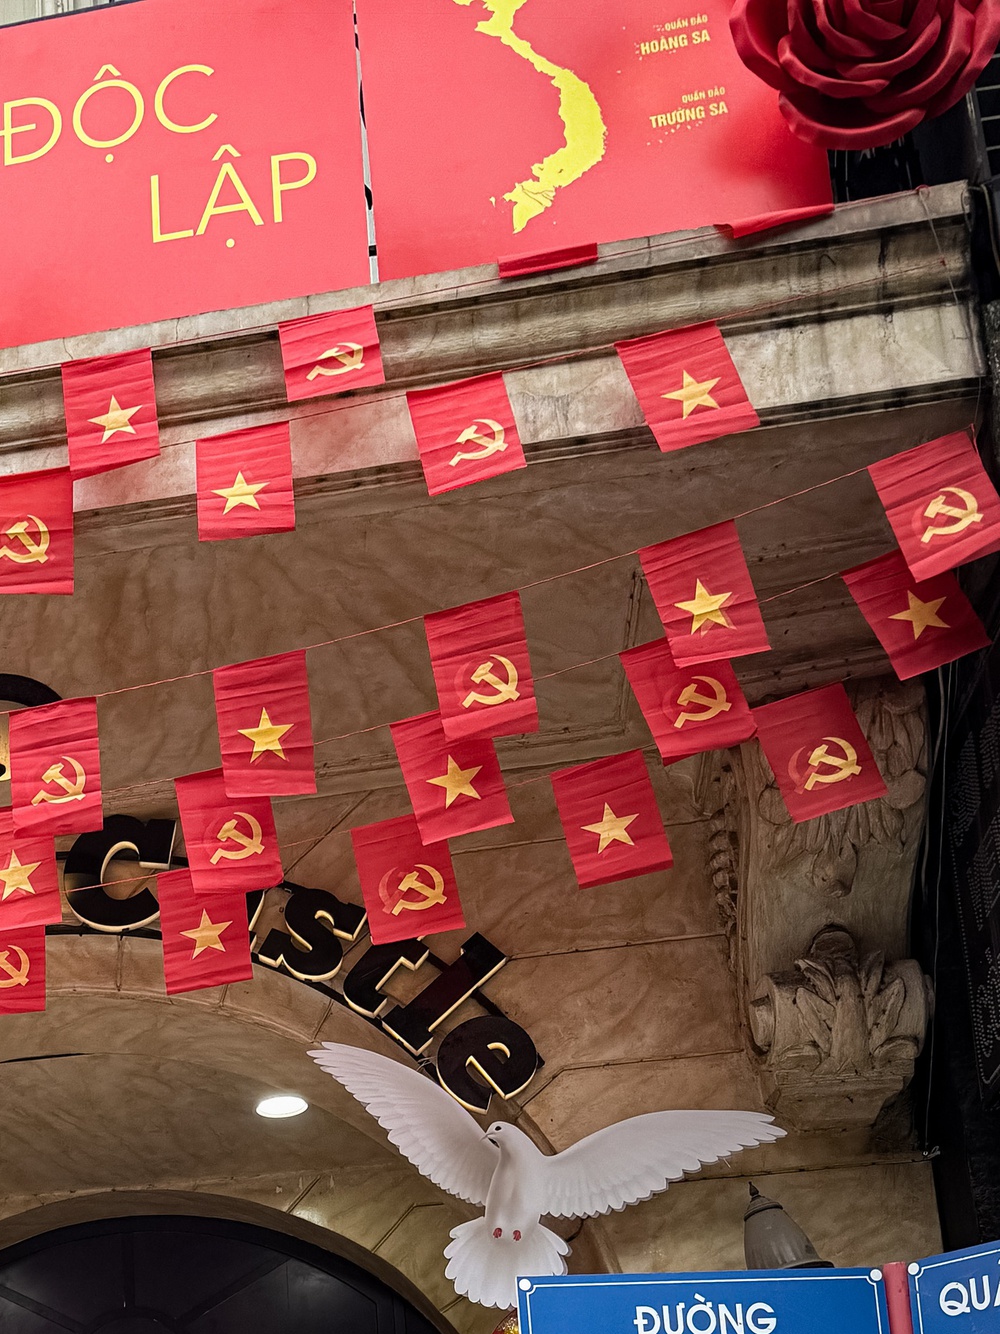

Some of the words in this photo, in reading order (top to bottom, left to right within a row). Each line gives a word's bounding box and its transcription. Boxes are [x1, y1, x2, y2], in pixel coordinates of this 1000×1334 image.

[640, 35, 688, 55] HOÀNG
[692, 29, 711, 44] SA
[649, 107, 705, 128] TRƯỜNG
[709, 101, 728, 116] SA
[150, 144, 317, 248] LẬP
[939, 1264, 1000, 1317] QU
